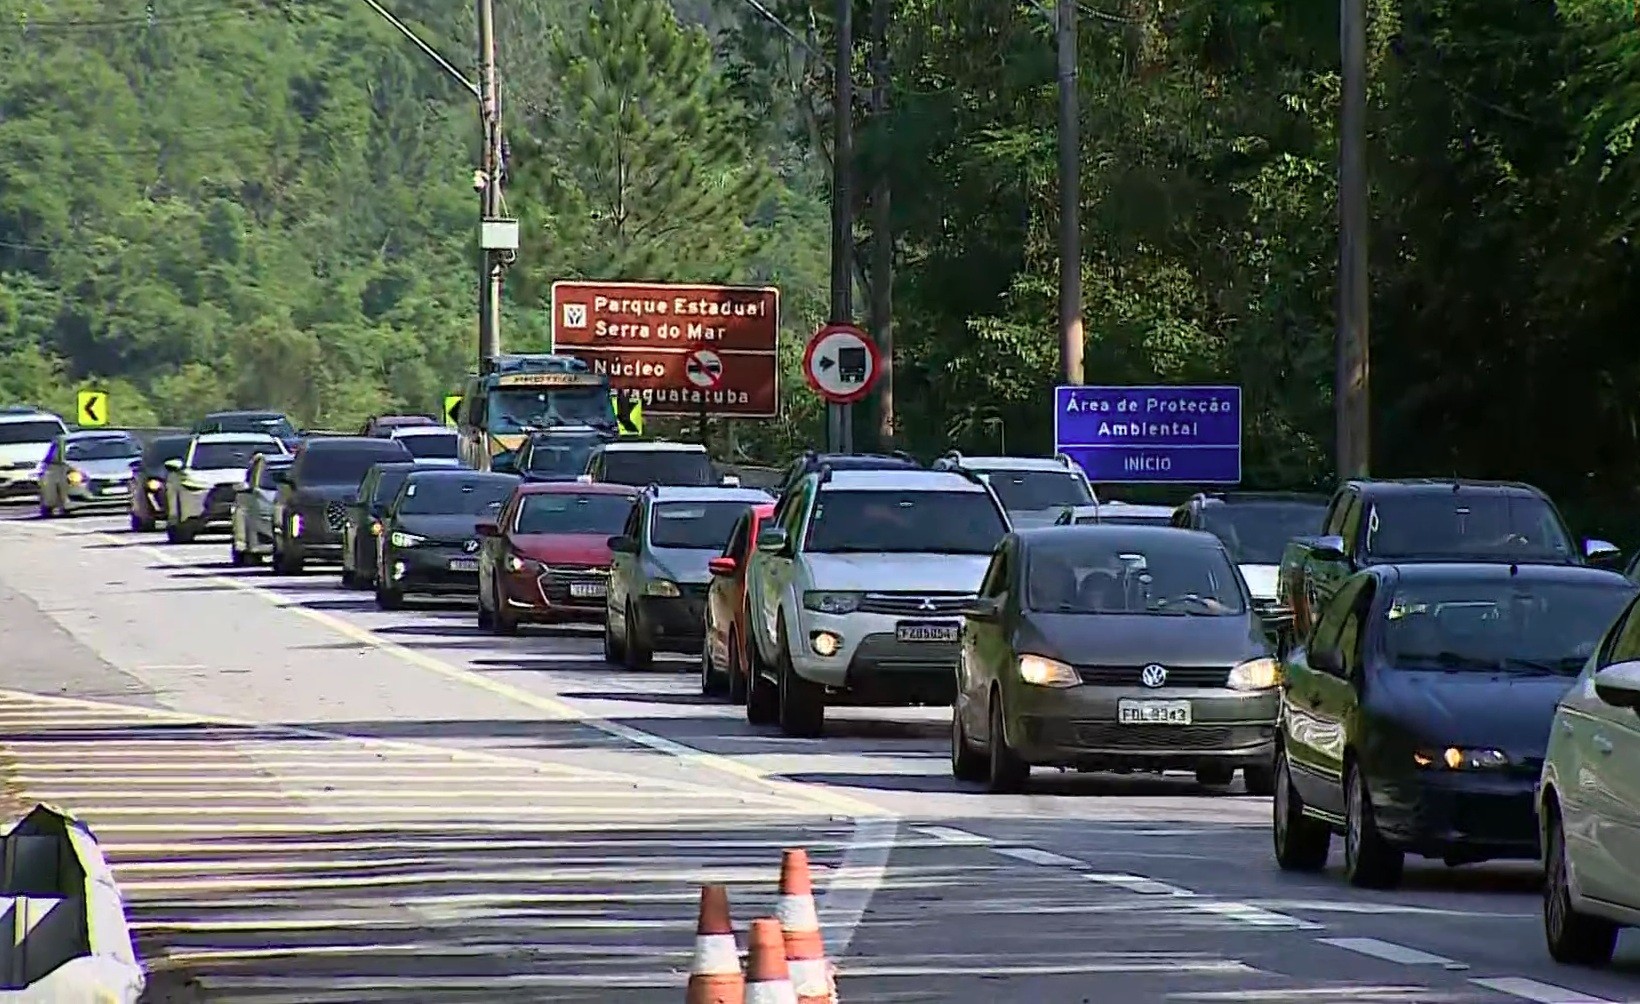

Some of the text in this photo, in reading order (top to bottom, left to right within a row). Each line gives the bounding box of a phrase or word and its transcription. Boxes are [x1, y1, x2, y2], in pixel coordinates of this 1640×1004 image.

[594, 296, 766, 318] Parque Estadual
[595, 320, 726, 340] Serra do Mar
[593, 356, 665, 377] Núcleo
[1066, 391, 1231, 414] Área de Proteção
[1098, 421, 1198, 436] Ambiental
[1124, 453, 1171, 471] INÍCIO
